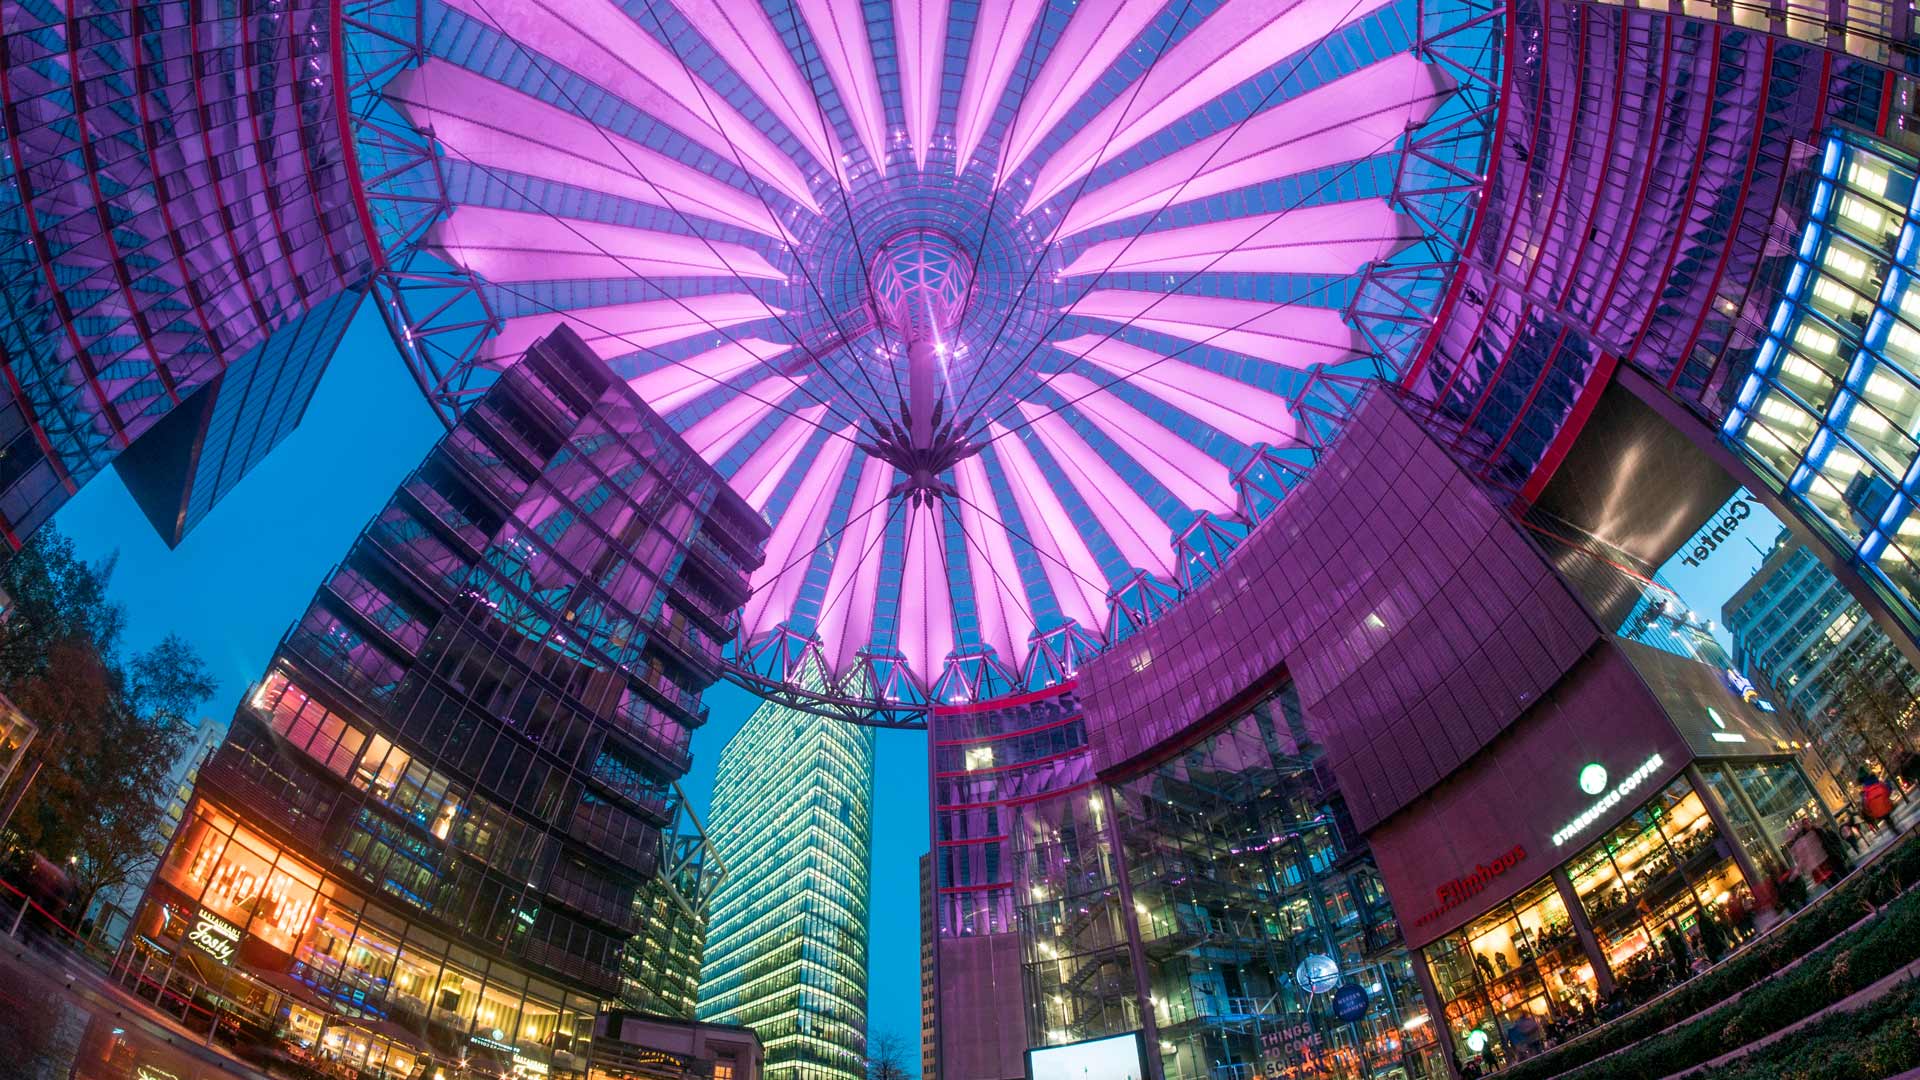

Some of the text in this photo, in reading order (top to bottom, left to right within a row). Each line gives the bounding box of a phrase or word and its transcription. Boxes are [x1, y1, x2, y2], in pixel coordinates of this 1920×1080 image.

[1552, 753, 1664, 846] STARBUCKS COFFEE
[1436, 844, 1526, 905] Filmhaus
[188, 921, 234, 960] Josty
[198, 909, 241, 938] RESTAURANT
[1260, 1022, 1311, 1047] THINGS
[1264, 1032, 1323, 1058] TO COME
